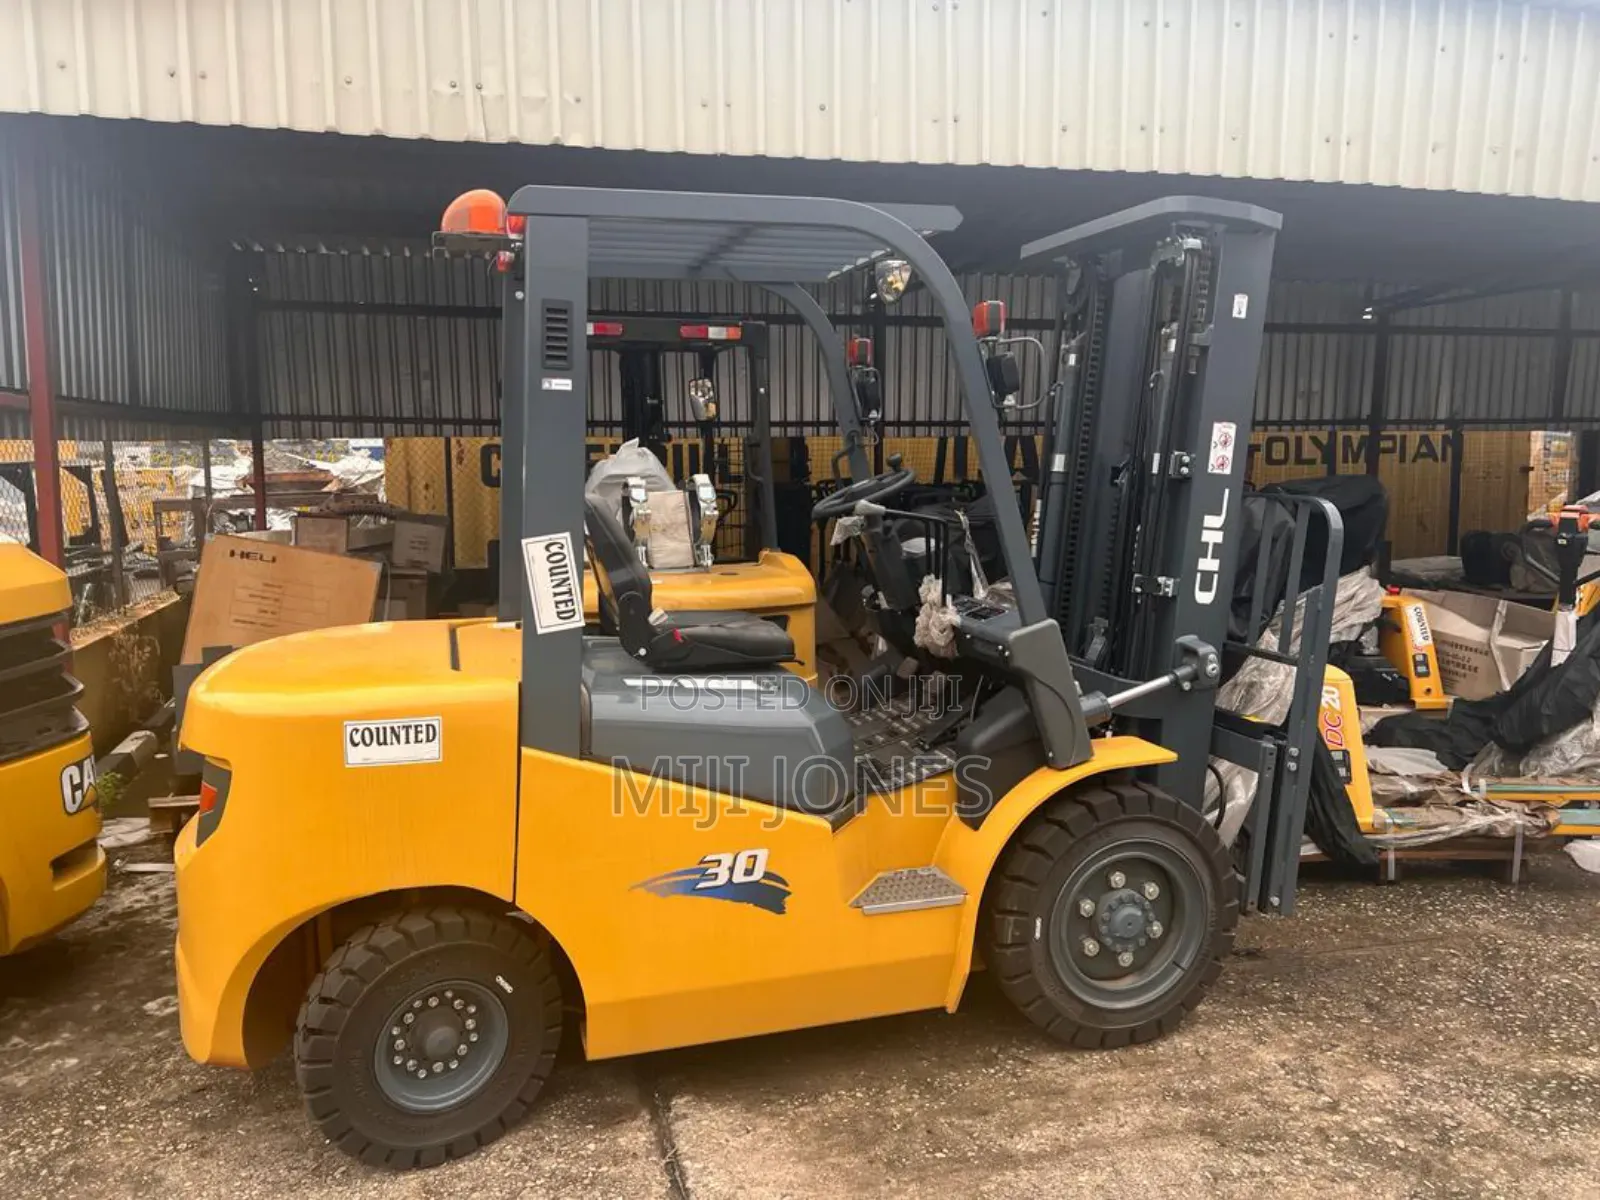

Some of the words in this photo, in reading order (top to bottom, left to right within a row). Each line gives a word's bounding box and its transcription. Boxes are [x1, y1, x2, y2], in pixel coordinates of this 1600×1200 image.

[229, 549, 277, 564] HELI
[1195, 488, 1230, 604] CHL
[544, 541, 576, 621] COUNTED
[1413, 606, 1429, 641] COUNTED
[349, 723, 437, 747] COUNTED
[61, 754, 96, 814] CA
[695, 848, 770, 890] 30
